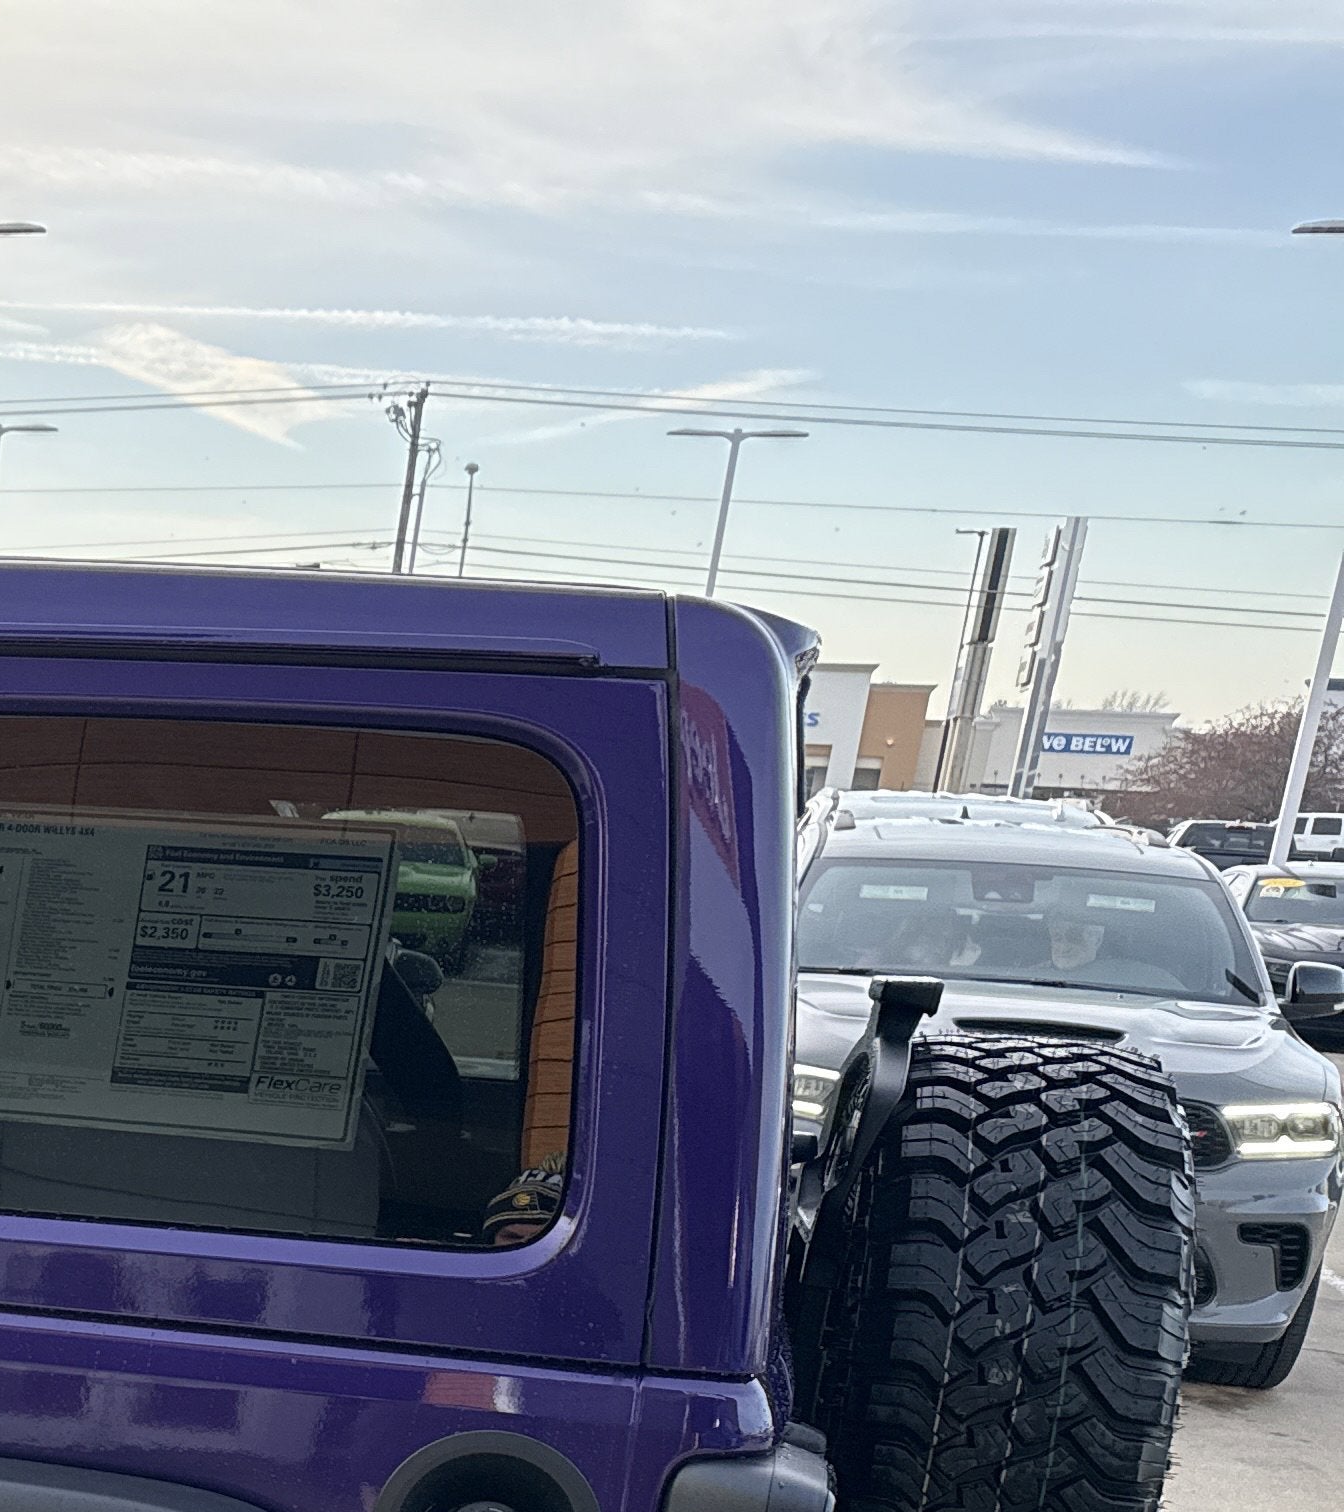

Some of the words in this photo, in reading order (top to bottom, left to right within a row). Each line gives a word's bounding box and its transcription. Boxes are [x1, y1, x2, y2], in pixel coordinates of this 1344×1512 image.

[43, 825, 76, 836] WILLYS
[158, 870, 190, 893] 21
[329, 874, 363, 885] spend
[313, 884, 364, 899] $3,250
[171, 917, 194, 926] cost
[255, 1076, 341, 1094] FlexCare
